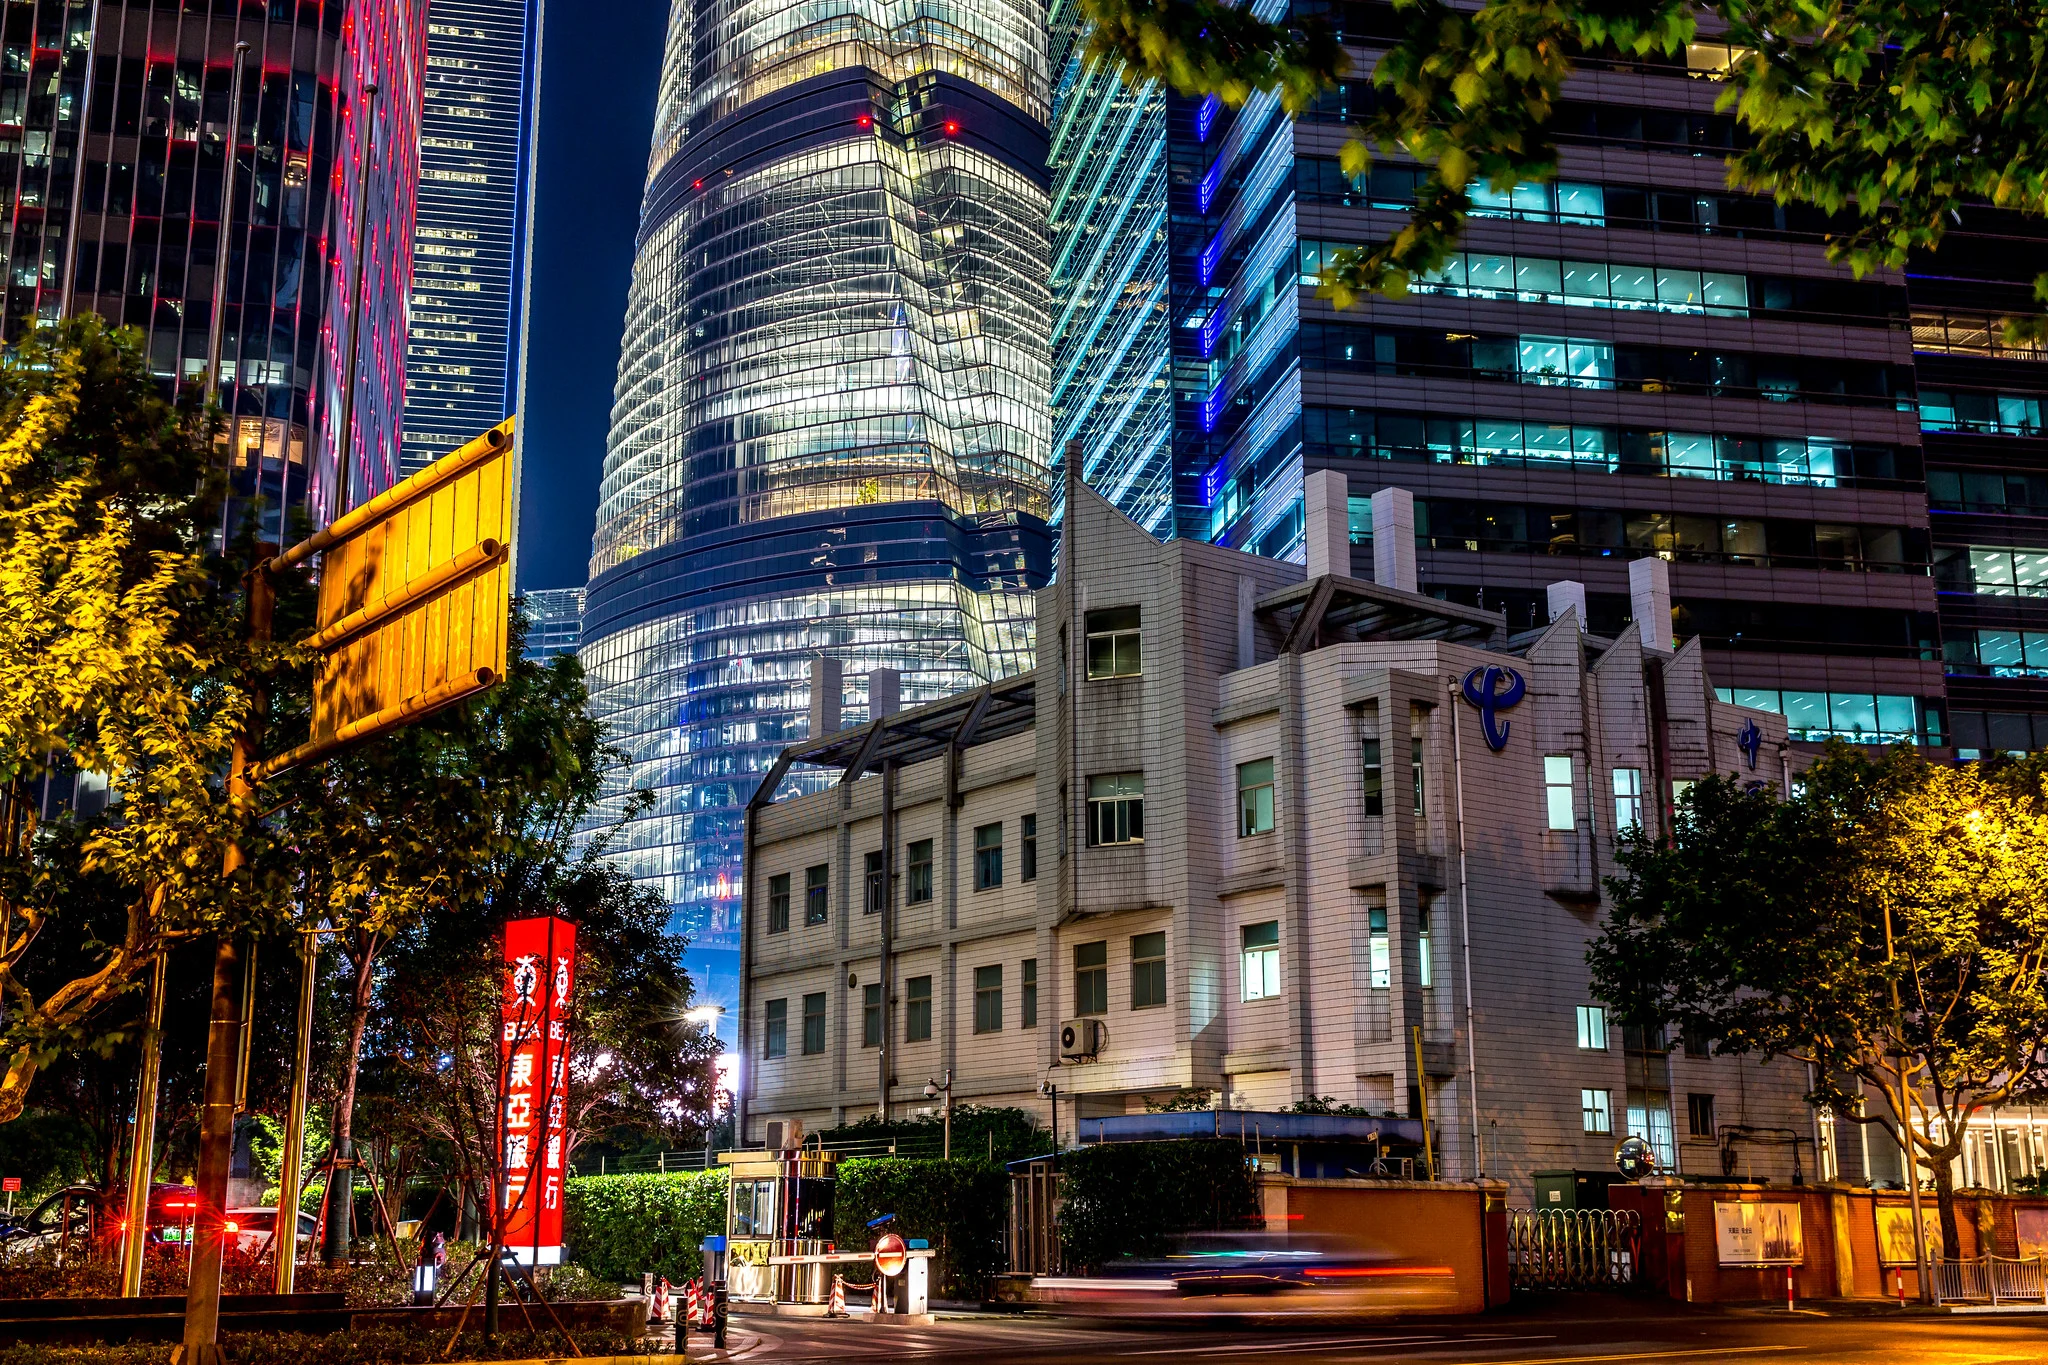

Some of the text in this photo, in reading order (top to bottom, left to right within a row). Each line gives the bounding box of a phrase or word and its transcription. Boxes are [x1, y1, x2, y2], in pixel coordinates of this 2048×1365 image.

[504, 1021, 541, 1041] BEA
[550, 1021, 569, 1042] BE
[505, 1053, 533, 1209] 東亞銀行
[545, 1053, 565, 1210] 東亞銀行
